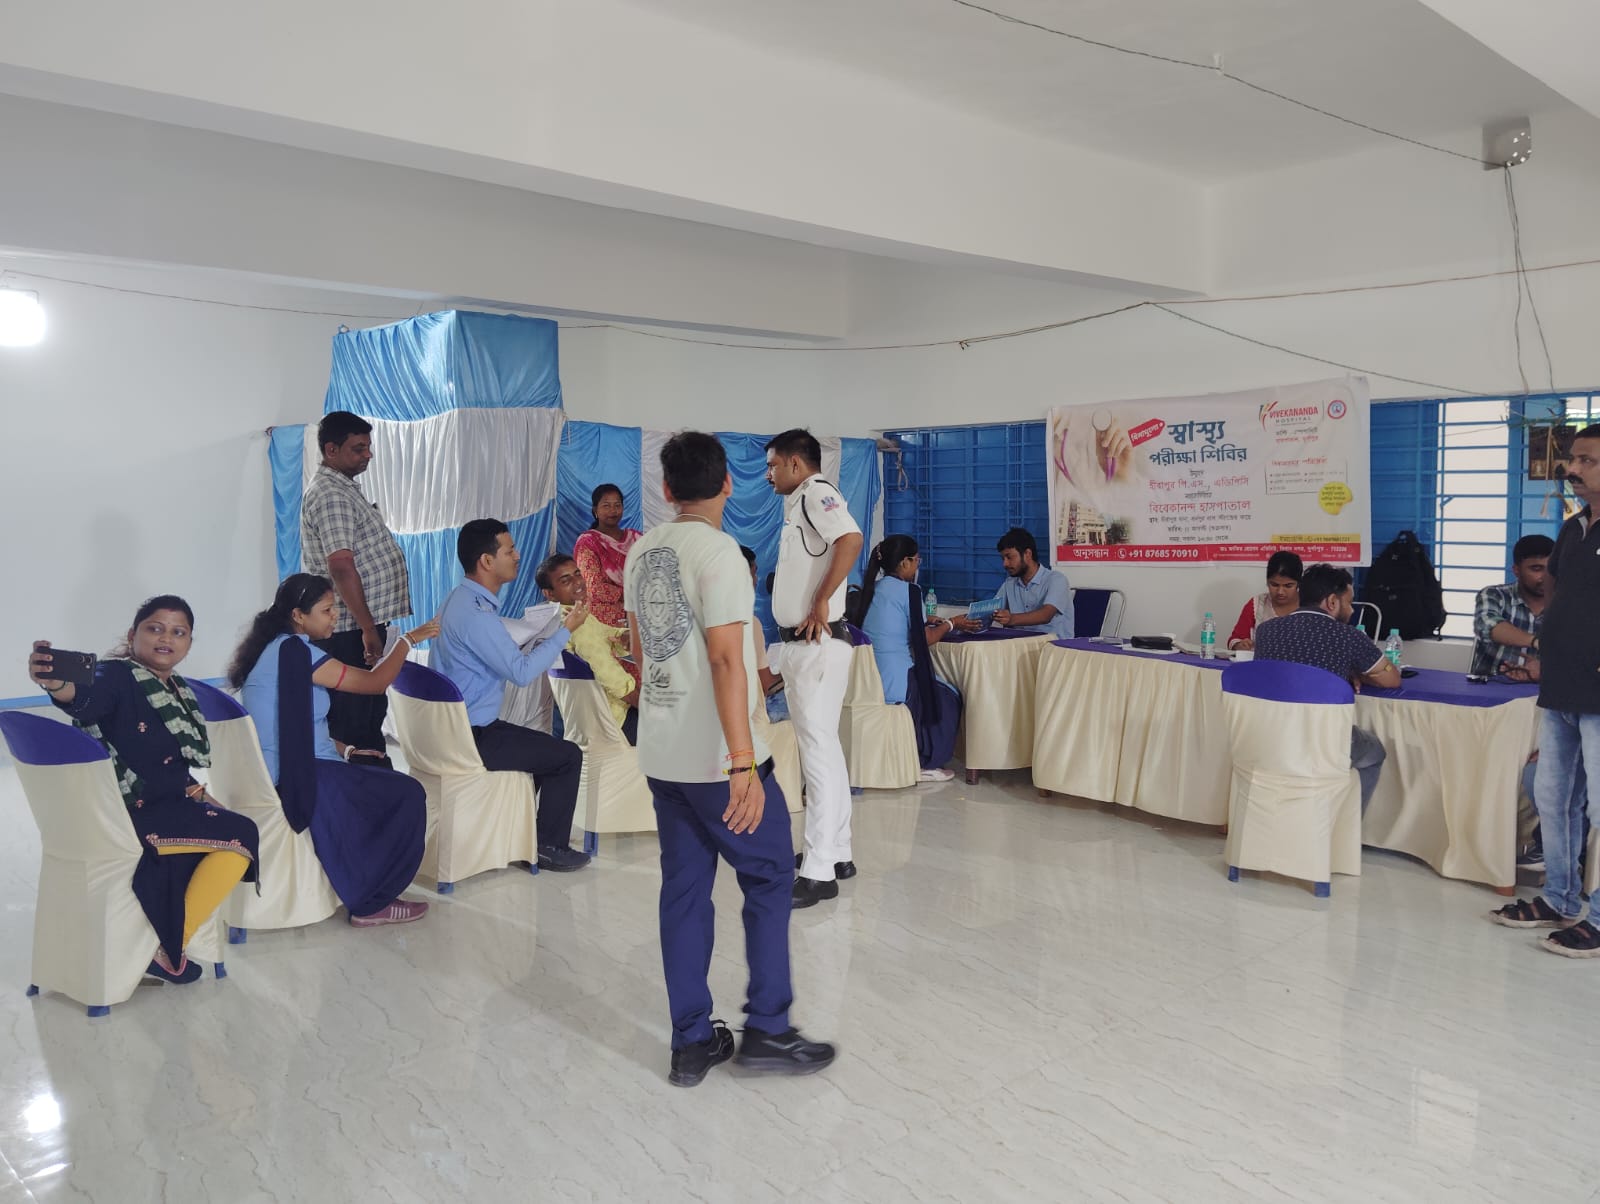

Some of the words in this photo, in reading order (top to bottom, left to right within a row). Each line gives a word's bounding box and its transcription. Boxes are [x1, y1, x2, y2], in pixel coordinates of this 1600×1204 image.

[1269, 406, 1319, 419] VIVEKANANDA
[1167, 420, 1226, 445] স্বাস্থ্য
[1149, 448, 1197, 467] পরীক্ষা
[1200, 443, 1247, 463] শিবির
[1149, 500, 1196, 513] বিবেকানন্দ
[1199, 500, 1251, 513] হাসপাতাল
[1073, 548, 1109, 559] অনুসন্ধান
[1129, 549, 1143, 558] +91
[1145, 549, 1170, 558] 87685
[1172, 548, 1198, 558] 70910
